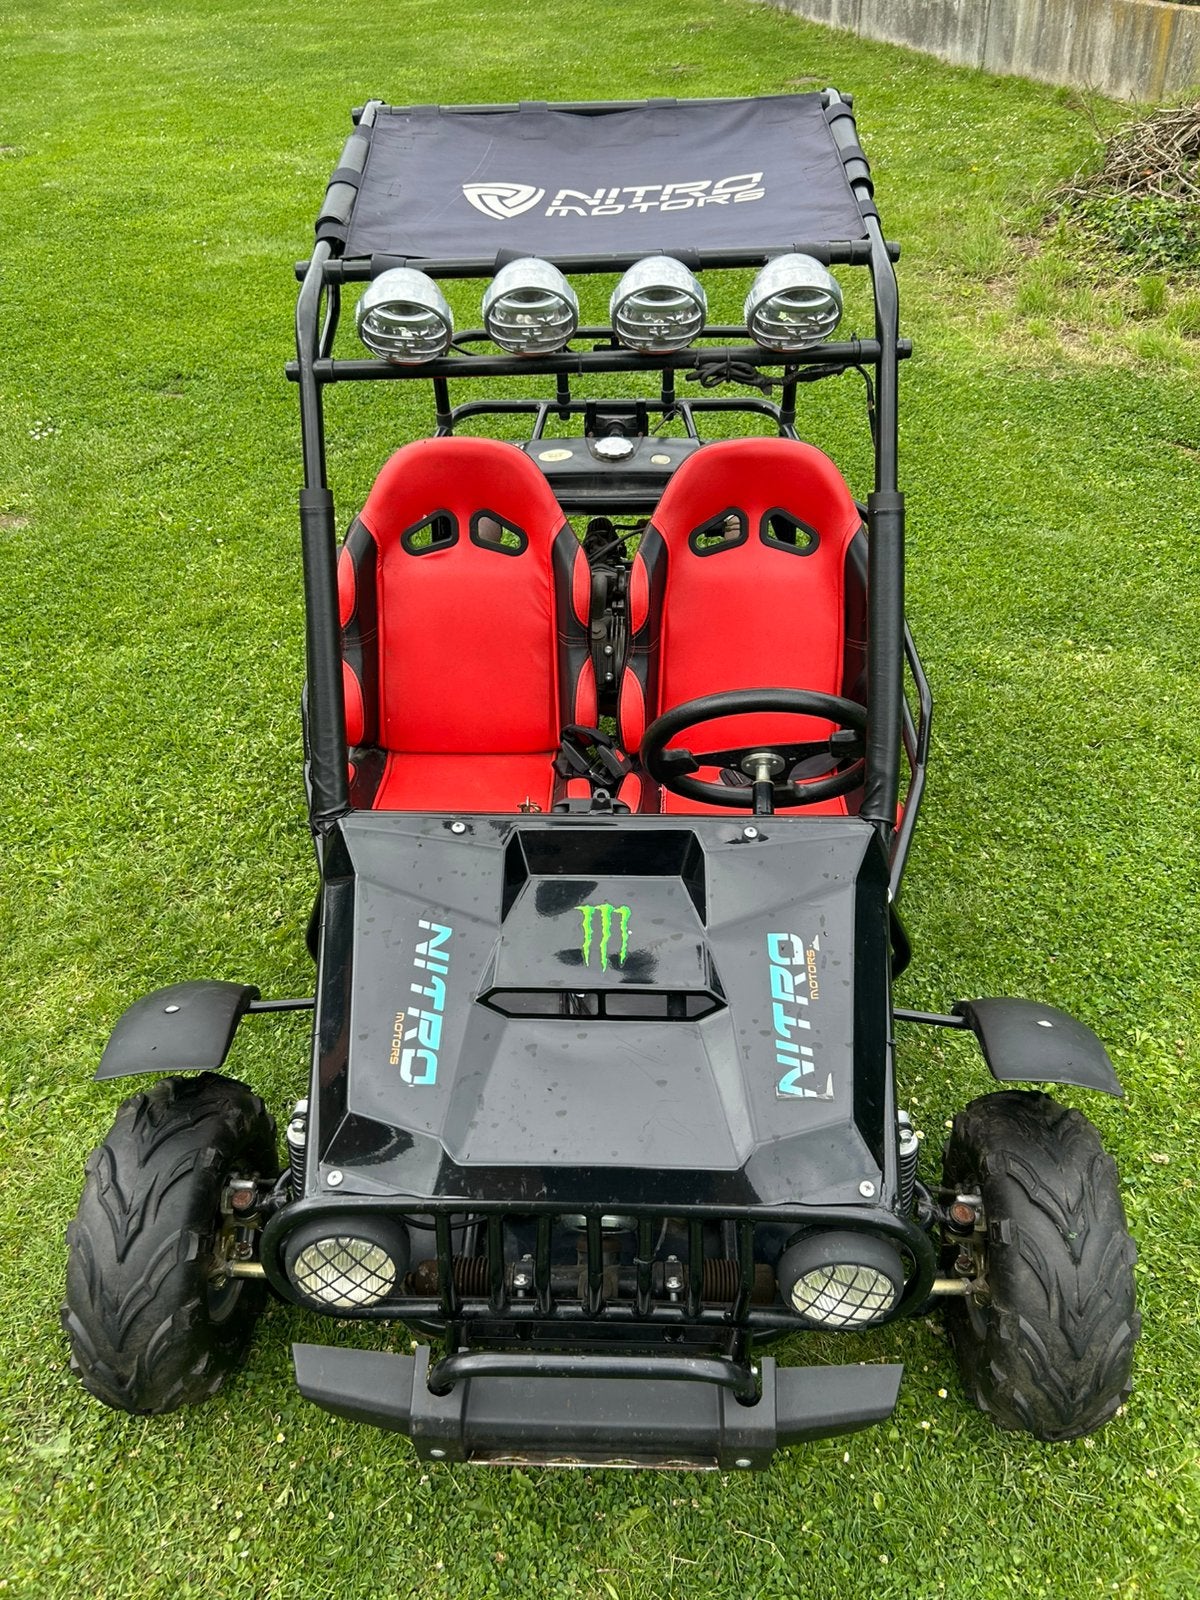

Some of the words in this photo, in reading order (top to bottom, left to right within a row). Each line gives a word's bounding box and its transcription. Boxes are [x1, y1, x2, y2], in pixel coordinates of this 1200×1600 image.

[545, 188, 765, 216] MOTORS
[553, 172, 763, 206] NITRO
[806, 949, 819, 1000] MOTORS
[400, 919, 452, 1085] NITRO
[767, 933, 817, 1098] NITRO
[390, 1012, 404, 1065] MOTORS
